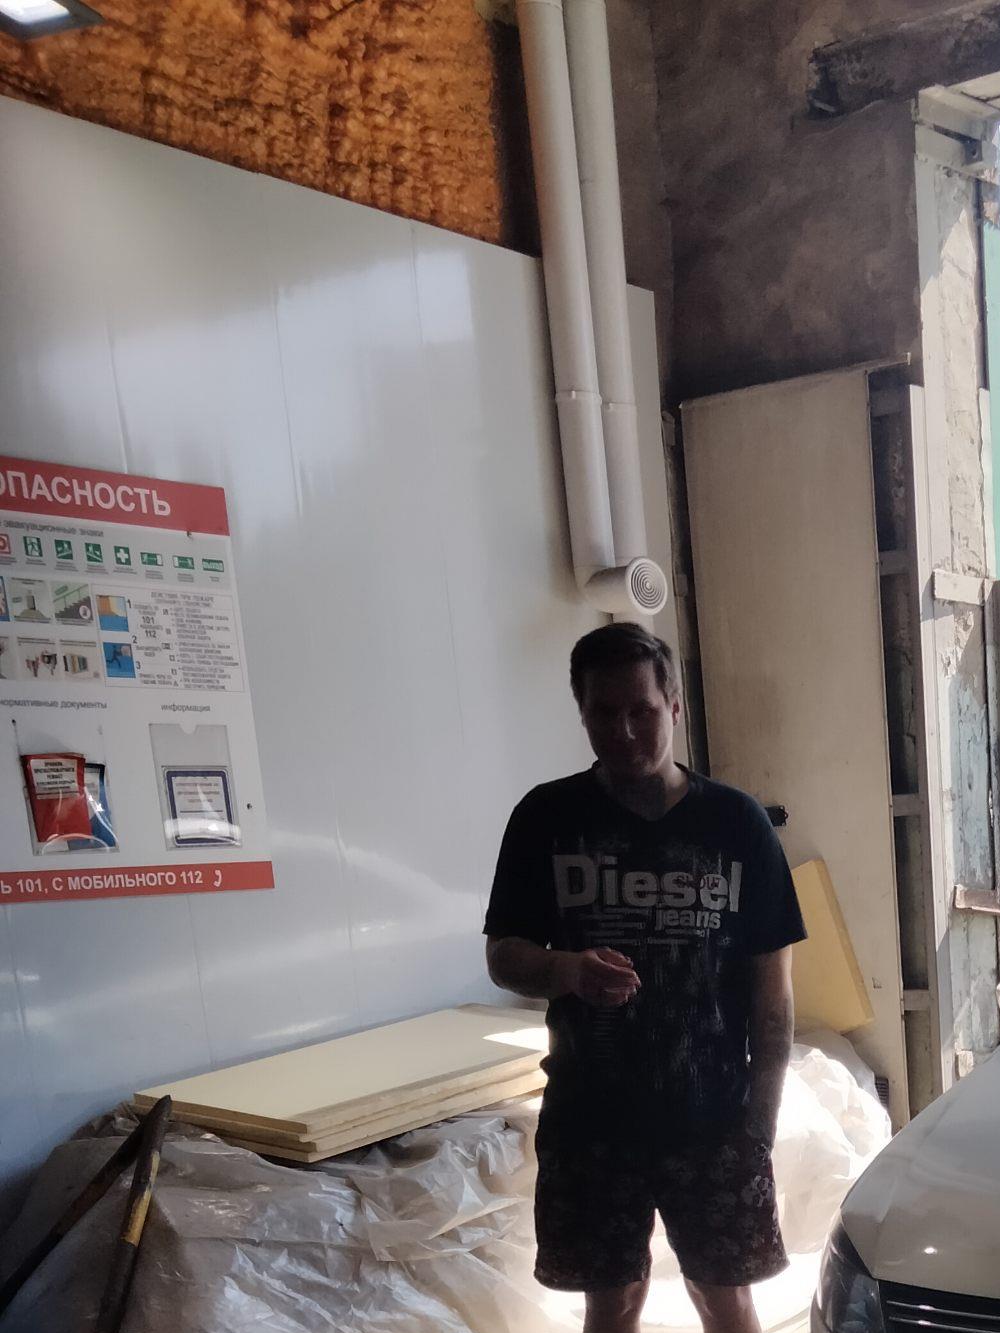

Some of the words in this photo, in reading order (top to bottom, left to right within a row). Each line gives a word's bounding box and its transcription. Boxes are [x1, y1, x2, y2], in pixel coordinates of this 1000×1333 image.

[0, 470, 171, 516] ПАСНОСТЬ
[160, 703, 211, 712] информация
[16, 878, 49, 894] 101,
[52, 877, 63, 892] С
[68, 872, 176, 891] МОБИЛЬНОГО
[180, 870, 204, 885] 112
[552, 854, 743, 912] Diesel
[655, 903, 722, 931] jeans
